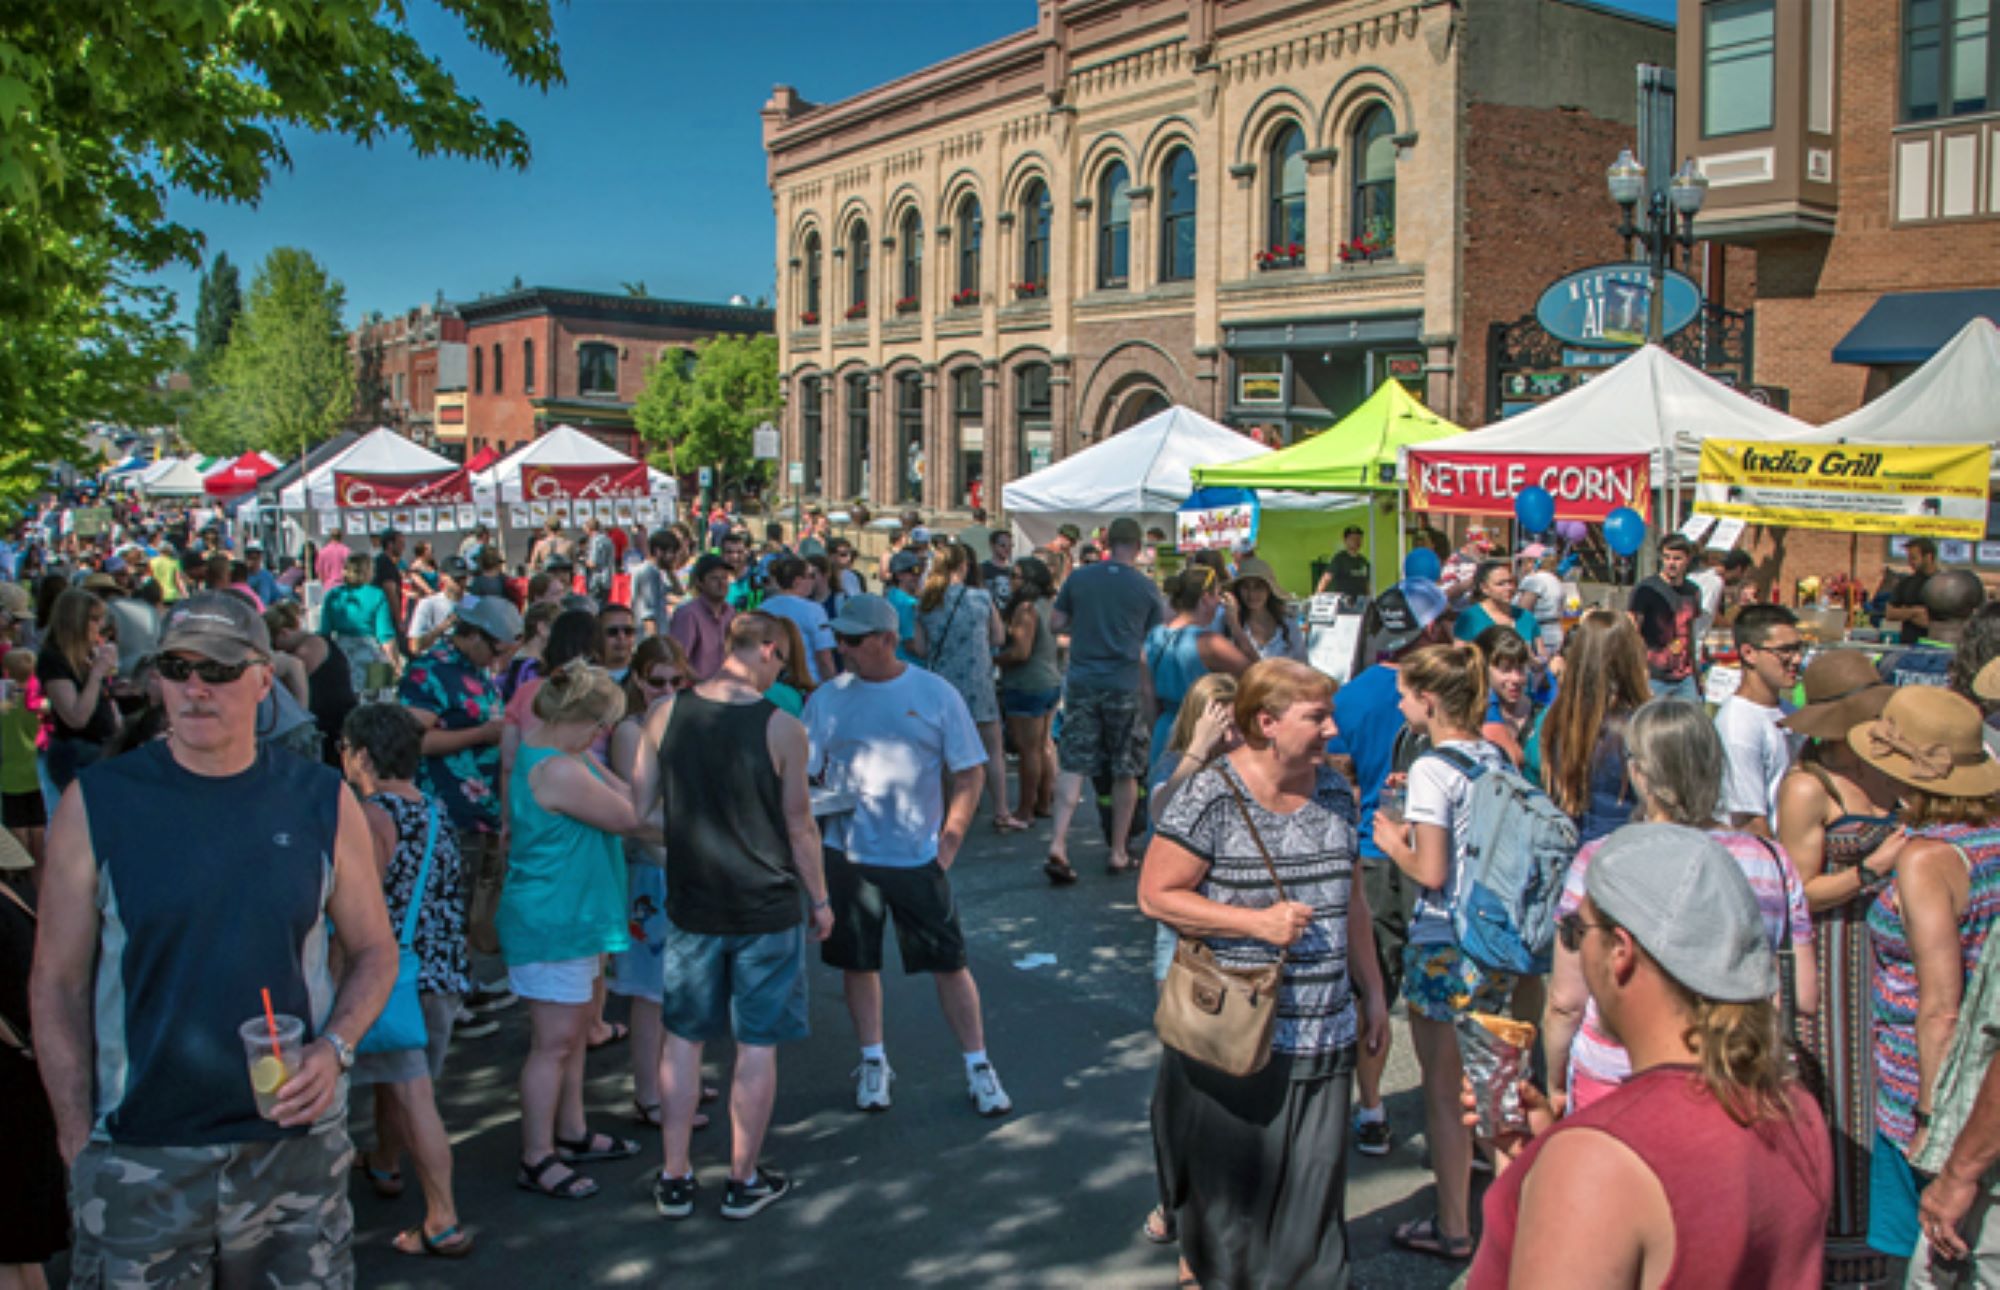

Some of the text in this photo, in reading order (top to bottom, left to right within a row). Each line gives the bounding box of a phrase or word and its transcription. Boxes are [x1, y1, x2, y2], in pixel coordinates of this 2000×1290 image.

[1743, 447, 1883, 478] India Grill
[533, 472, 642, 499] On Rice
[1420, 462, 1633, 502] KETTLE CORN
